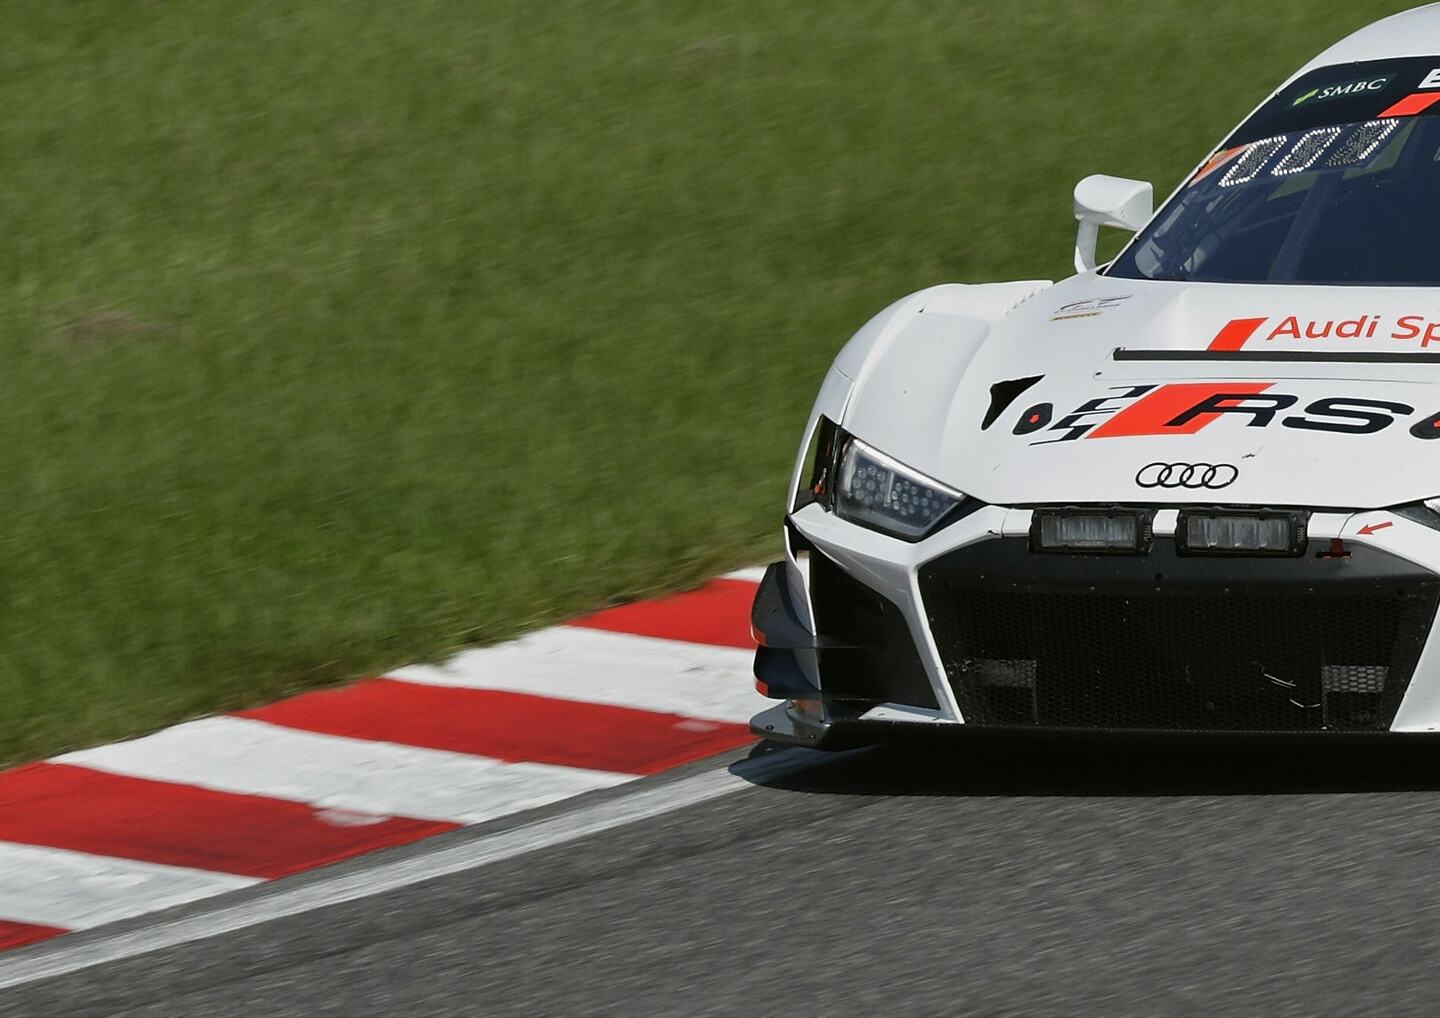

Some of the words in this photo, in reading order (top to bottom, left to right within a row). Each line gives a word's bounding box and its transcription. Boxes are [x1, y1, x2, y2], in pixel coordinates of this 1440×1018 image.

[1318, 78, 1388, 100] SMBC
[1266, 315, 1381, 341] Audi
[1162, 393, 1416, 435] RS
